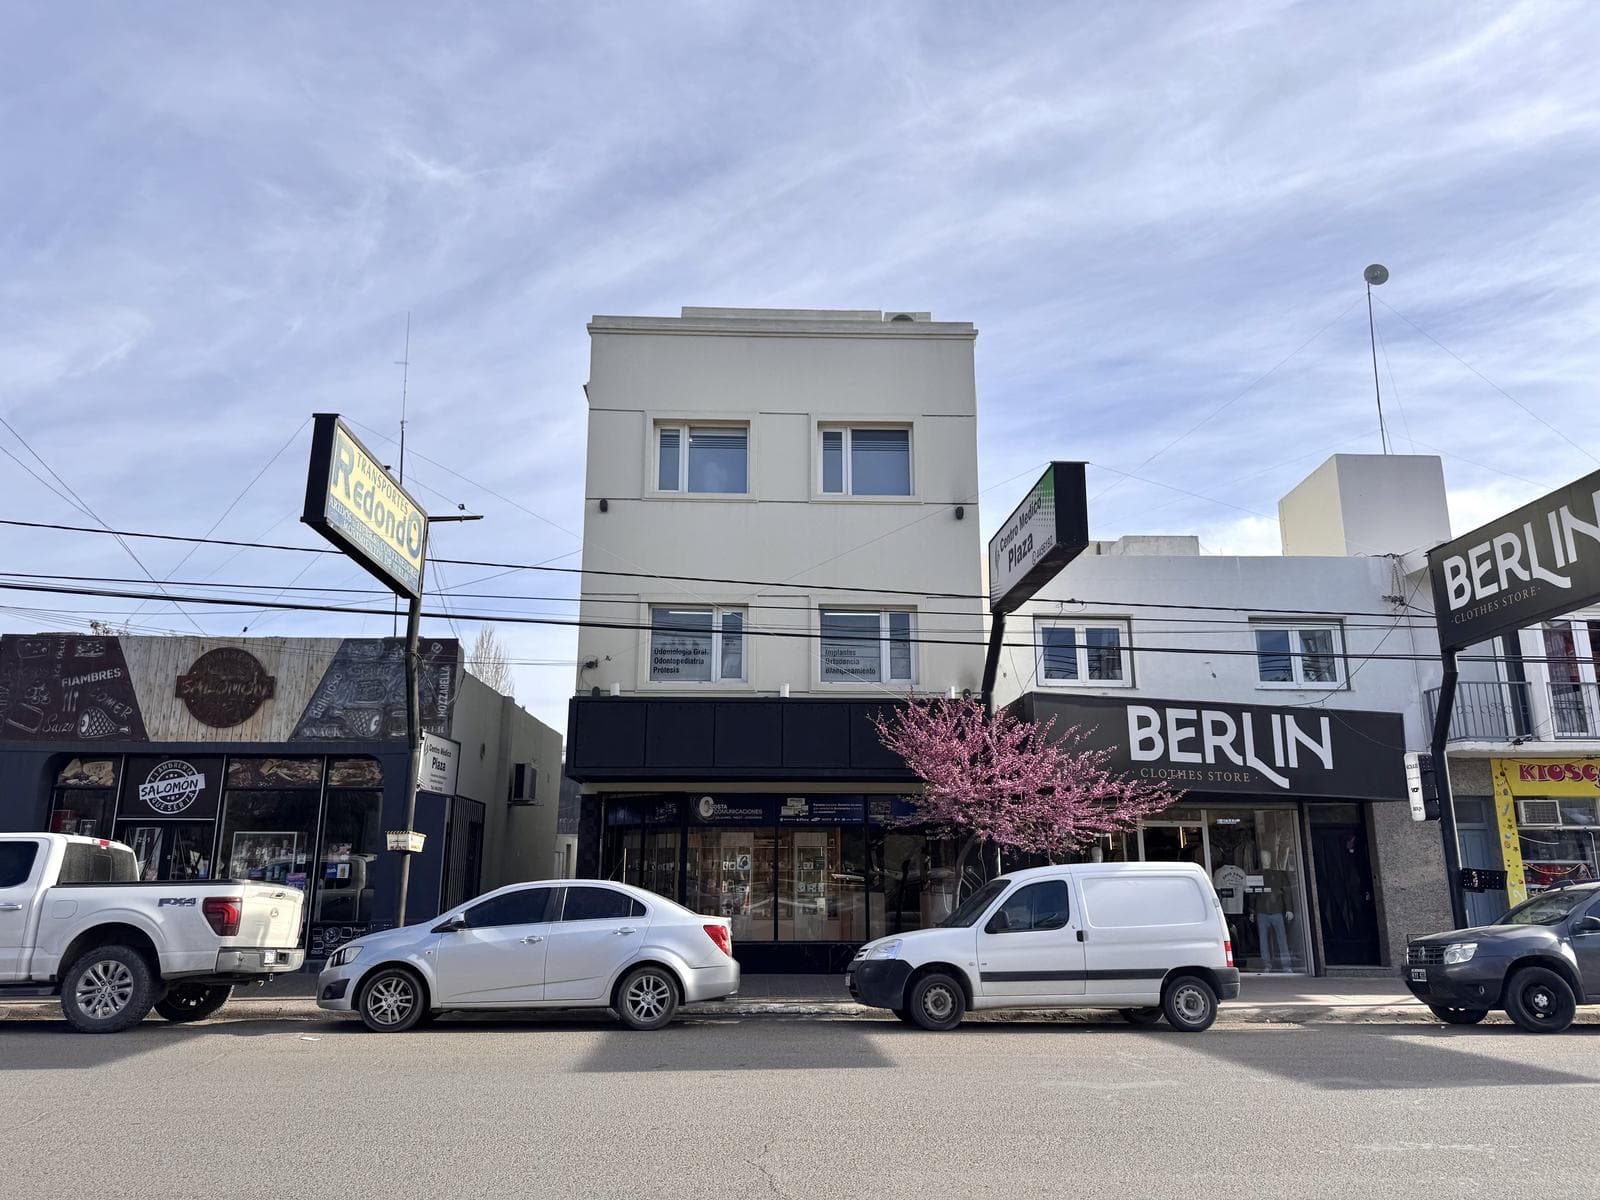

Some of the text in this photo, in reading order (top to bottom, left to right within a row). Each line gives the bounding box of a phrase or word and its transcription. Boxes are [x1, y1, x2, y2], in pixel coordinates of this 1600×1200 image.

[358, 452, 409, 516] TRANSPORTES
[1000, 523, 1019, 553] Centro
[1008, 533, 1034, 573] Plaza
[1443, 489, 1600, 611] BERLIN
[1454, 586, 1537, 625] CLOTHES STORE
[825, 649, 857, 658] Implantes
[61, 667, 122, 688] FIAMBRES
[437, 665, 451, 718] MOZZARELLA
[312, 673, 343, 720] delicioso
[432, 756, 446, 772] Plaza
[1127, 705, 1334, 789] BERLIN
[1140, 768, 1251, 783] CLOTHES STORE
[1519, 763, 1600, 789] KIOSC
[158, 897, 197, 908] FX4
